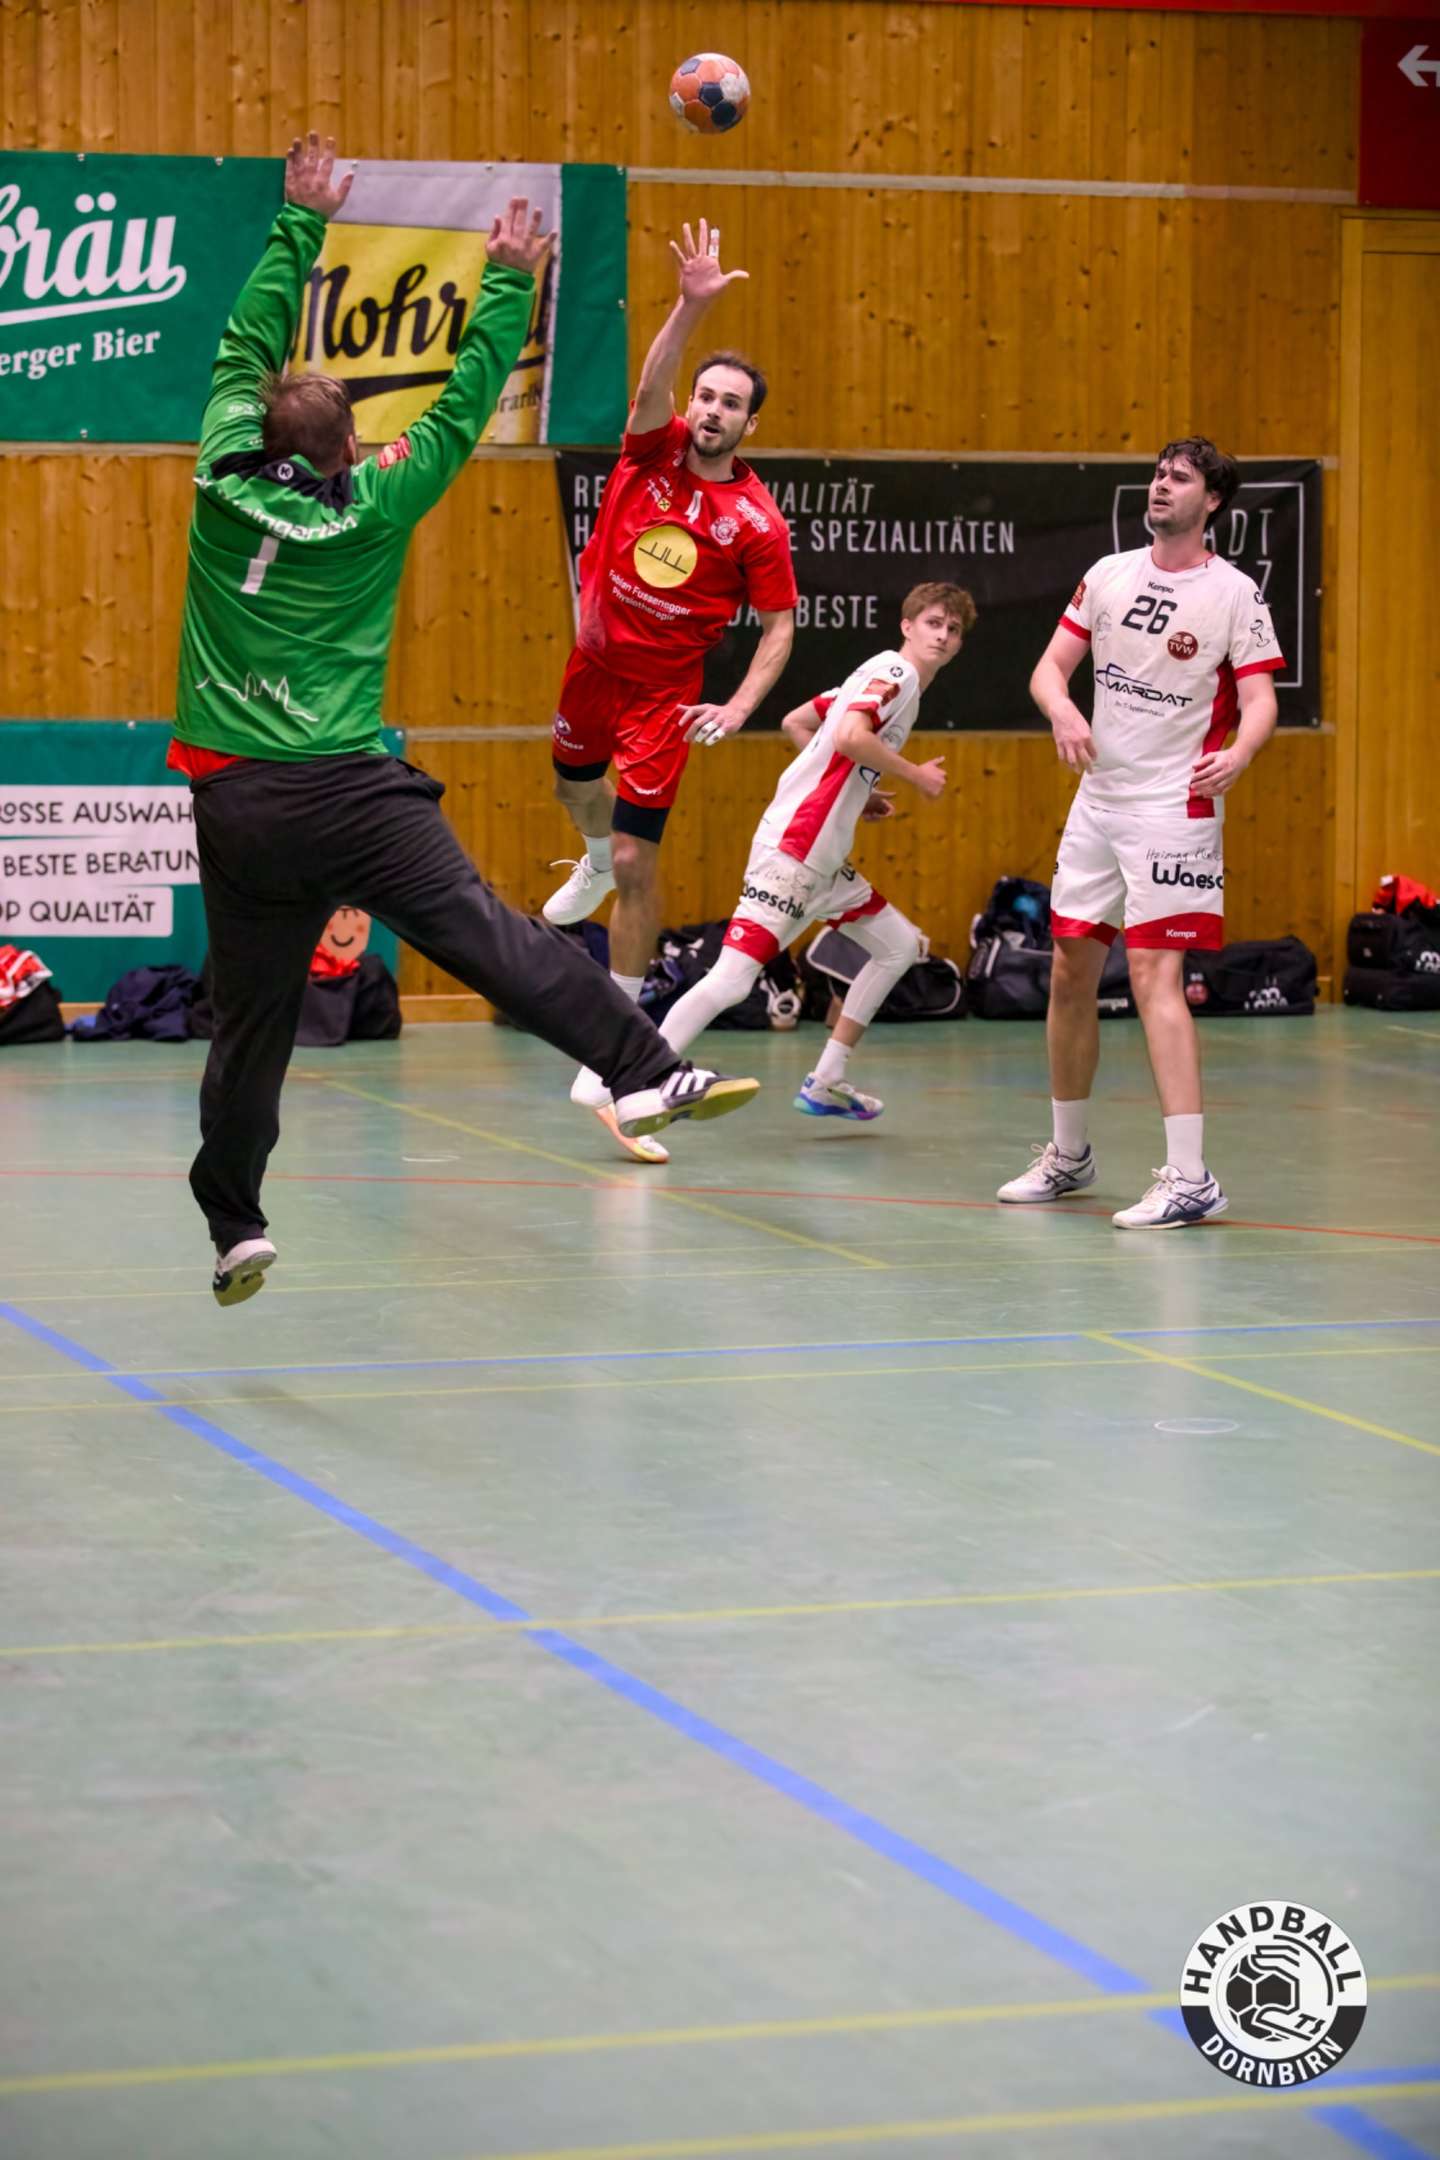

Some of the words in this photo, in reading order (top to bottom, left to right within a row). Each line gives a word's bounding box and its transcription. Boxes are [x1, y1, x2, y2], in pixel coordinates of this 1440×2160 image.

[93, 327, 161, 362] Bier
[773, 477, 875, 514] ALITÄT
[810, 515, 1016, 554] SPEZIALITÄTEN
[240, 535, 280, 595] 1
[795, 595, 879, 629] BESTE
[1120, 594, 1178, 635] 26
[1169, 640, 1197, 655] TVW
[0, 801, 63, 824] OSSE
[72, 801, 194, 824] AUSWAH
[3, 853, 78, 878] BESTE
[86, 849, 200, 875] BERATUN
[1151, 861, 1224, 890] Waesc
[29, 893, 156, 923] QUALITÄT
